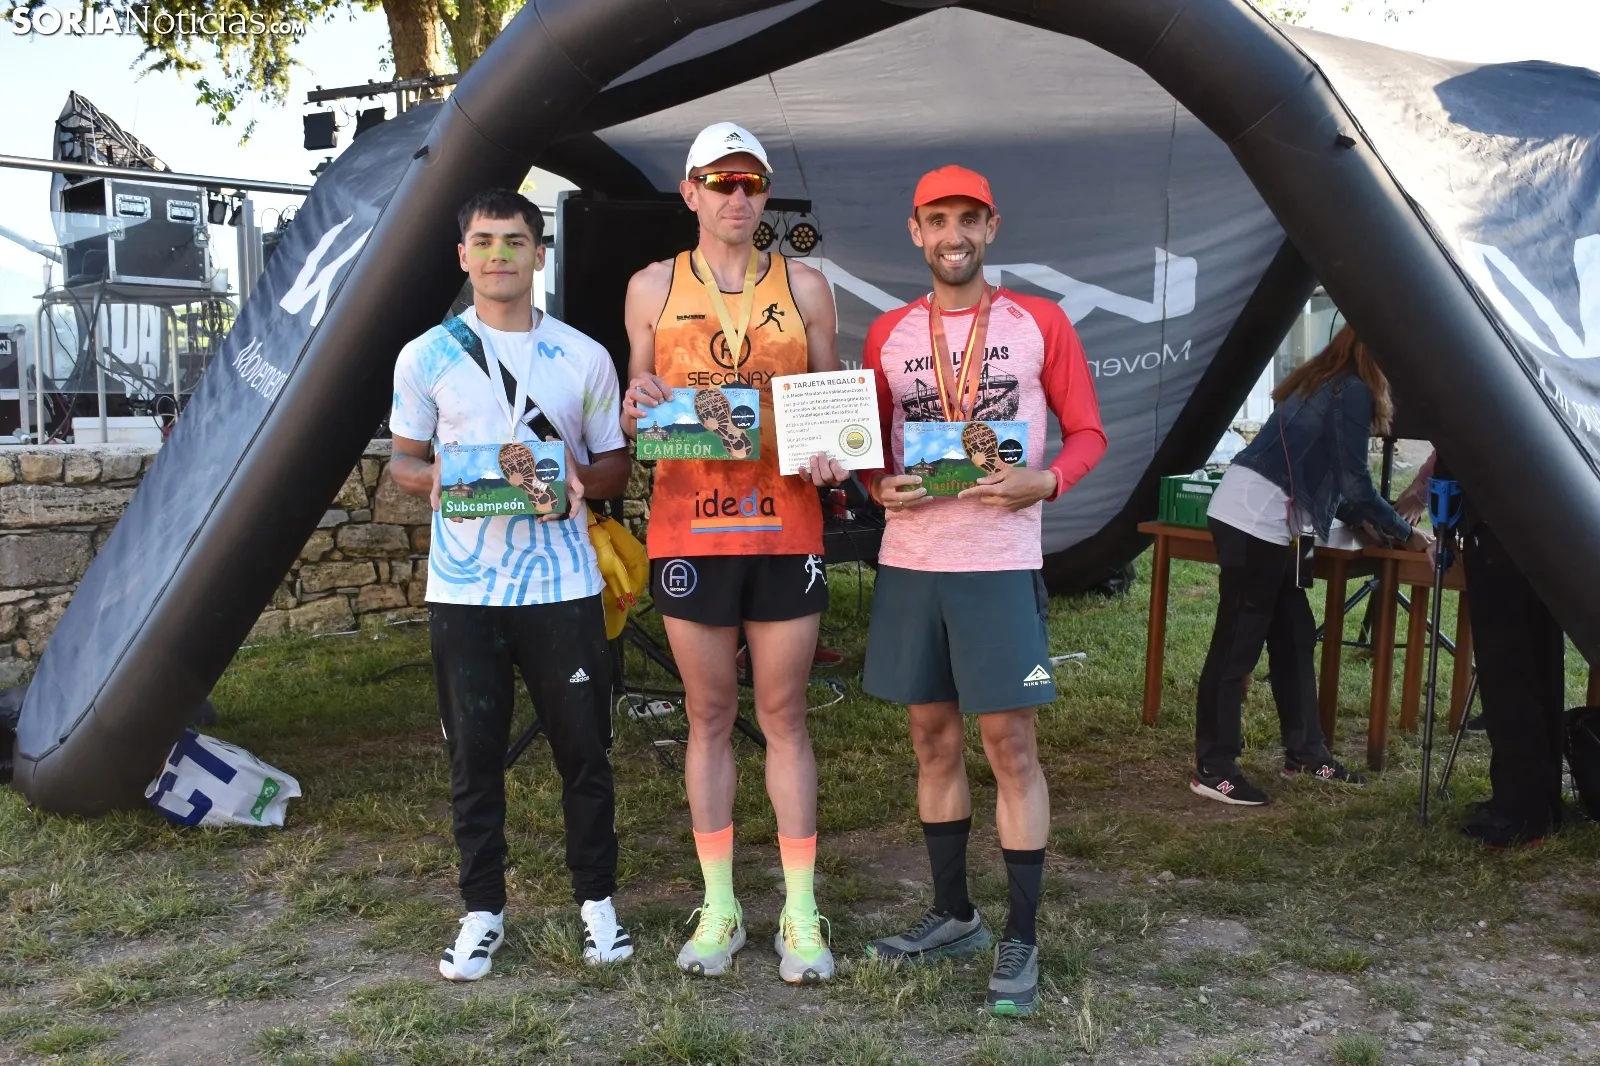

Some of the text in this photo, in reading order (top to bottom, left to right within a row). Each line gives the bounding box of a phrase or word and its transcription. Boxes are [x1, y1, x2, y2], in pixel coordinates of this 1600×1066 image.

[232, 336, 291, 402] Movemen
[793, 377, 856, 389] TARJETA REGALO
[962, 426, 980, 437] CROSS
[643, 441, 712, 456] CAMPEÓN
[446, 497, 525, 513] Subcampeón
[695, 487, 776, 518] ideda
